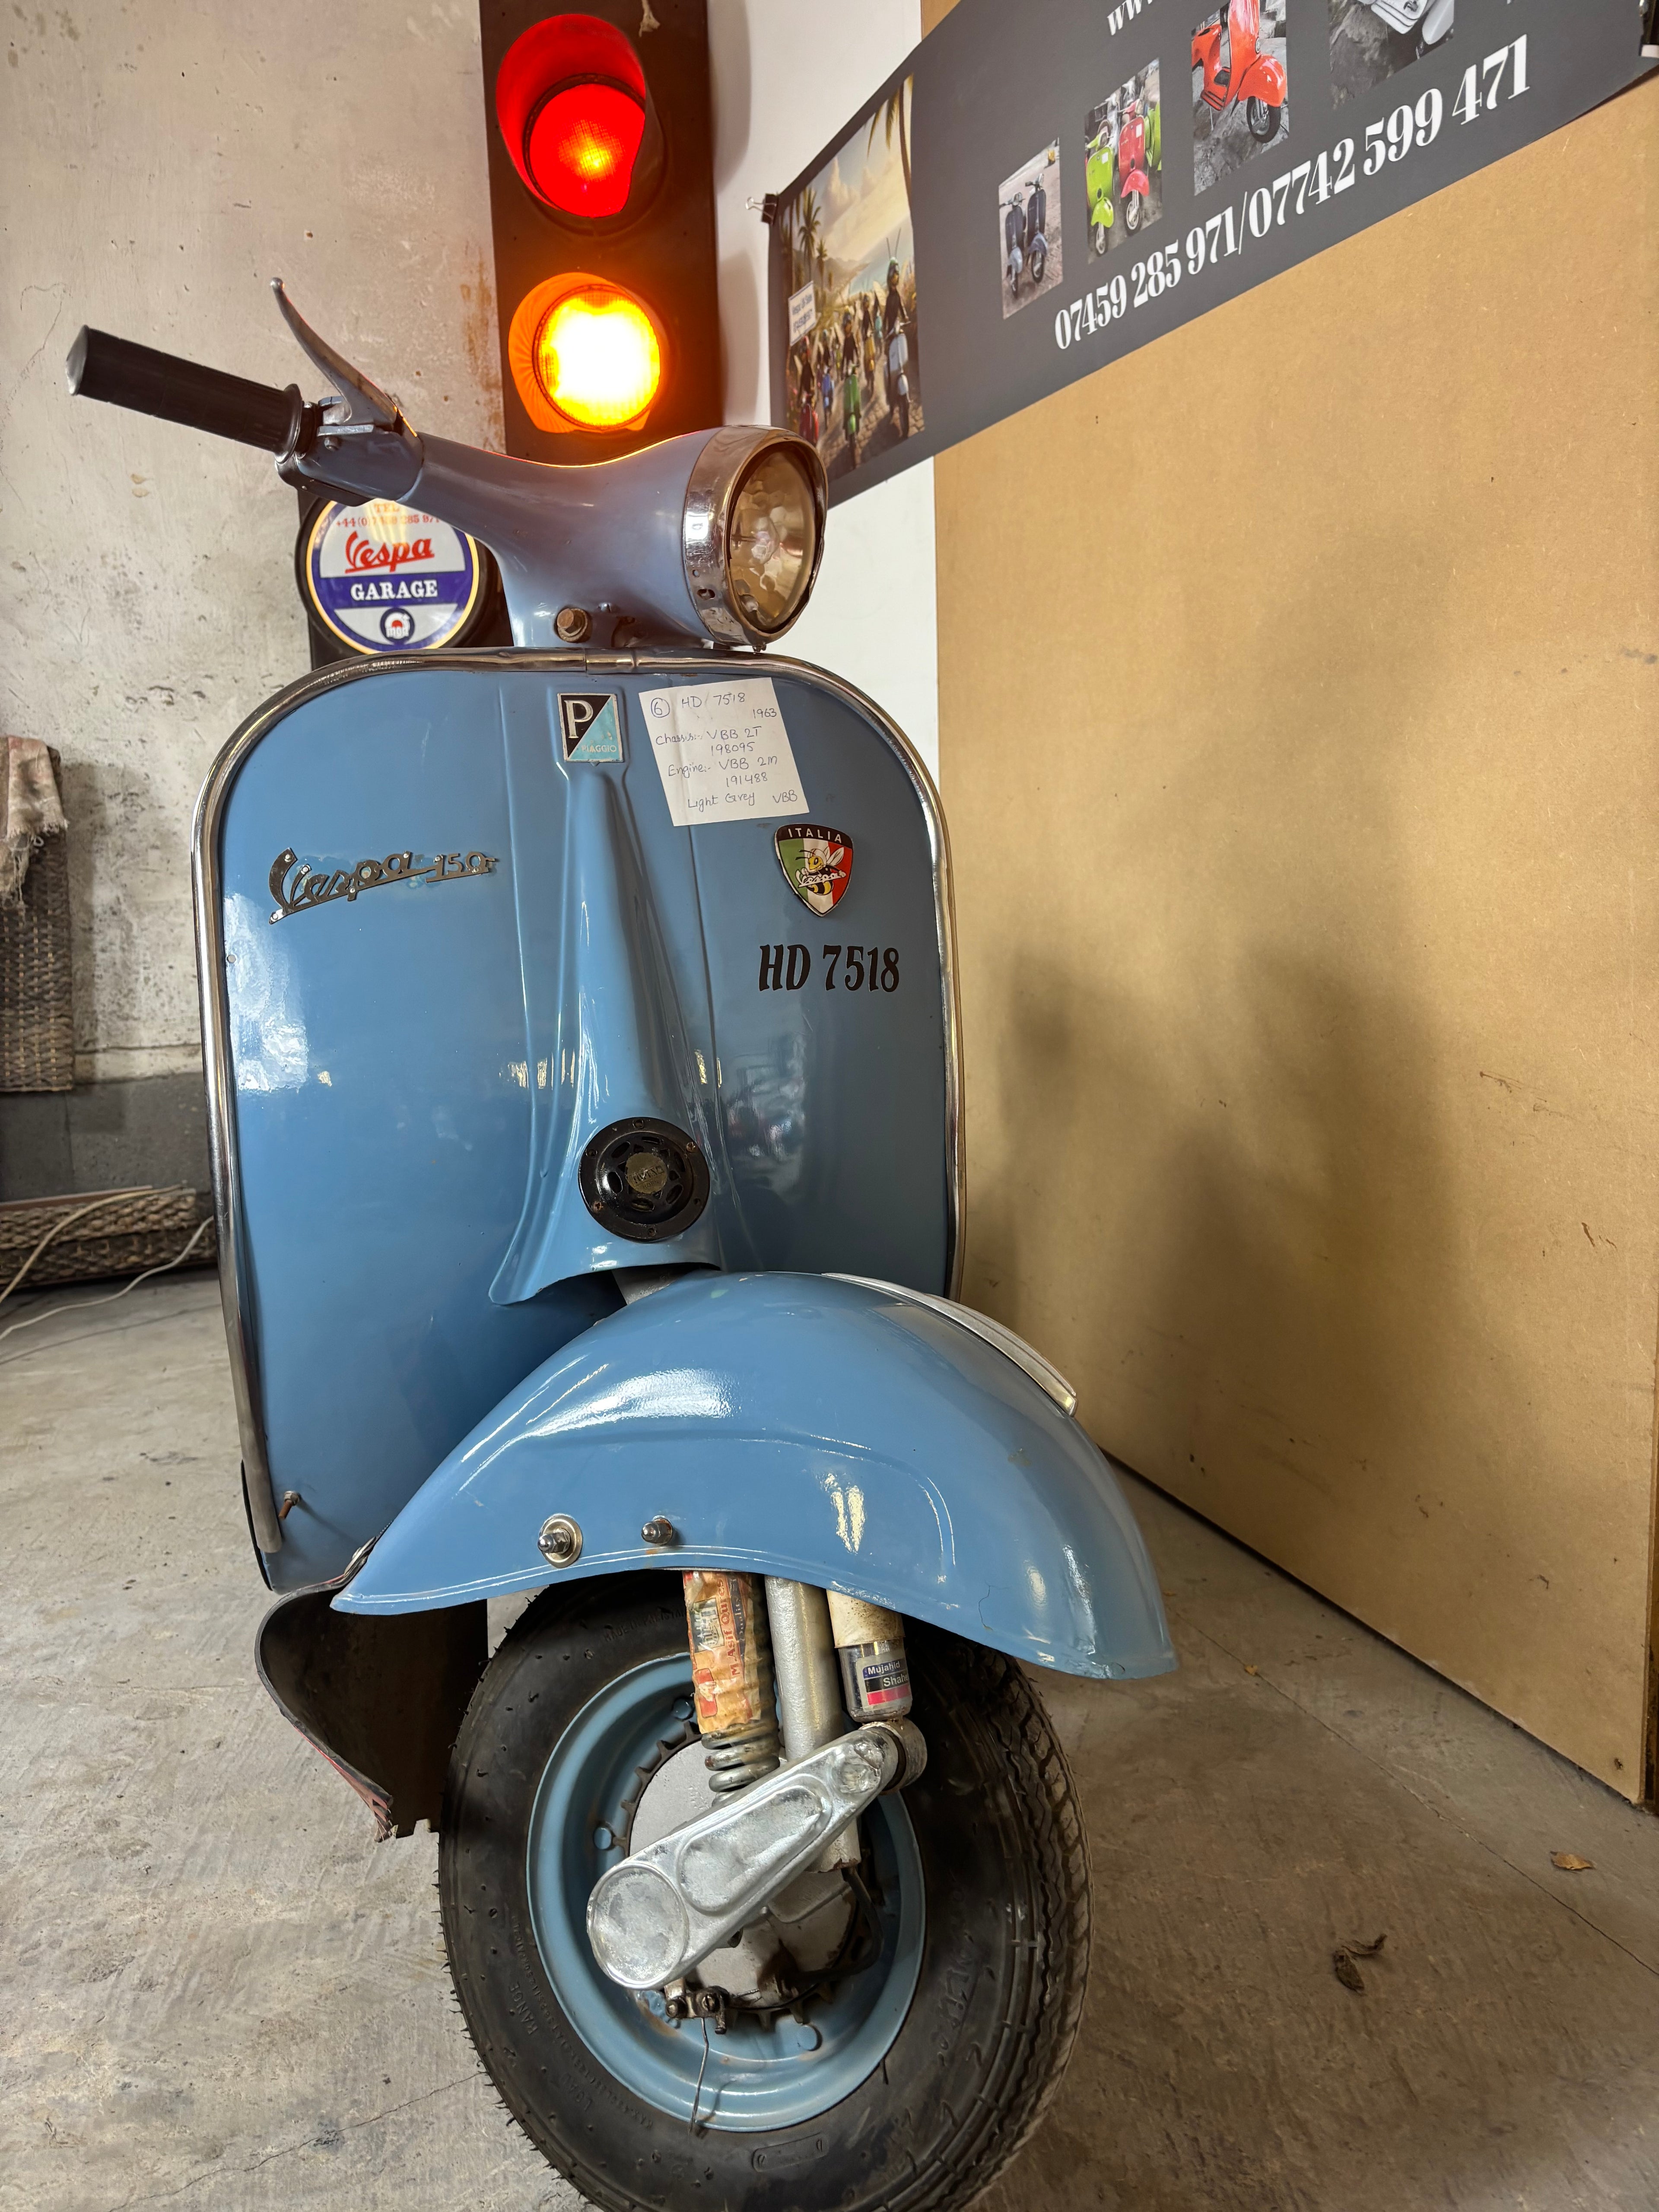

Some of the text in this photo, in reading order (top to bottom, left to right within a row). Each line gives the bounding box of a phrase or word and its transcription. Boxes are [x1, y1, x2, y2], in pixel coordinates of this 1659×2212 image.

[1106, 0, 1153, 36] ww
[1054, 34, 1530, 350] 07459 285 971/07742 599 471
[374, 503, 400, 513] TEL
[345, 531, 435, 574] Vespa
[350, 579, 438, 601] GARAGE
[682, 696, 702, 708] HD
[713, 692, 745, 706] 7518
[564, 699, 594, 738] P
[753, 708, 777, 719] 1963
[707, 729, 738, 740] VBB
[744, 726, 762, 737] 2T
[711, 741, 755, 756] 198095
[719, 757, 749, 770] VBB
[726, 772, 768, 788] 191488
[688, 790, 798, 812] Light Grey VBB
[788, 828, 842, 843] ITALIA
[269, 847, 496, 925] Vespa 150
[759, 944, 899, 992] HD 7518
